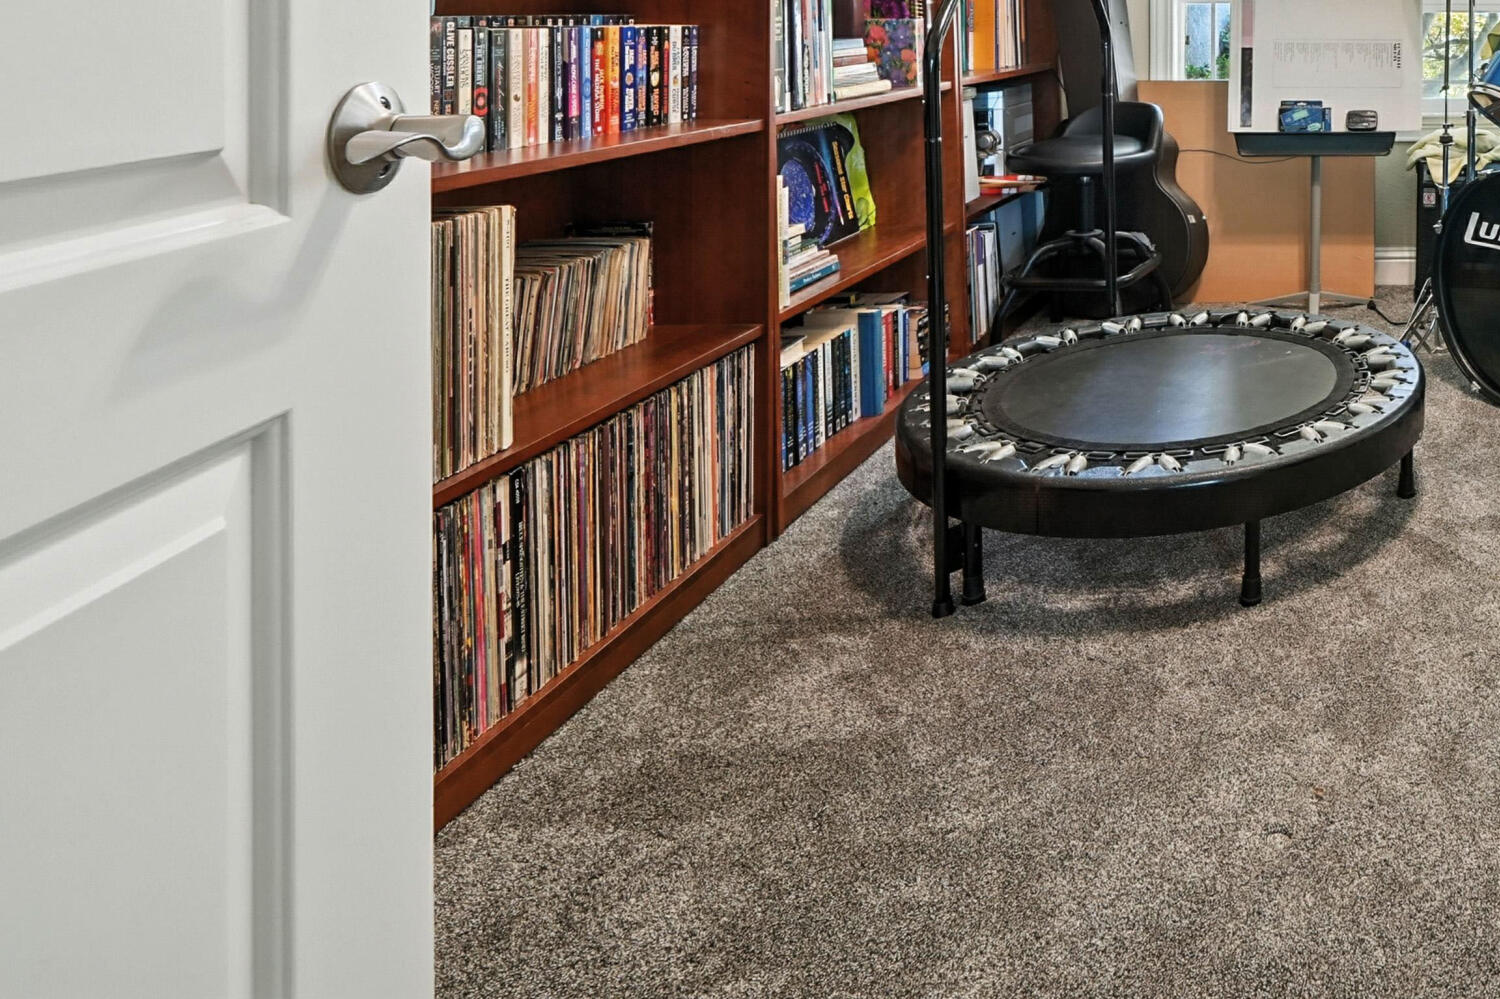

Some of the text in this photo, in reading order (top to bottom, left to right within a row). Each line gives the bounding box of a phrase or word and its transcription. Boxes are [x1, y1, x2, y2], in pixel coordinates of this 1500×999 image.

[446, 22, 455, 87] CLIVE CUSSLER
[476, 45, 485, 86] THE ENEMY
[832, 141, 854, 220] Seasonal Star Charts
